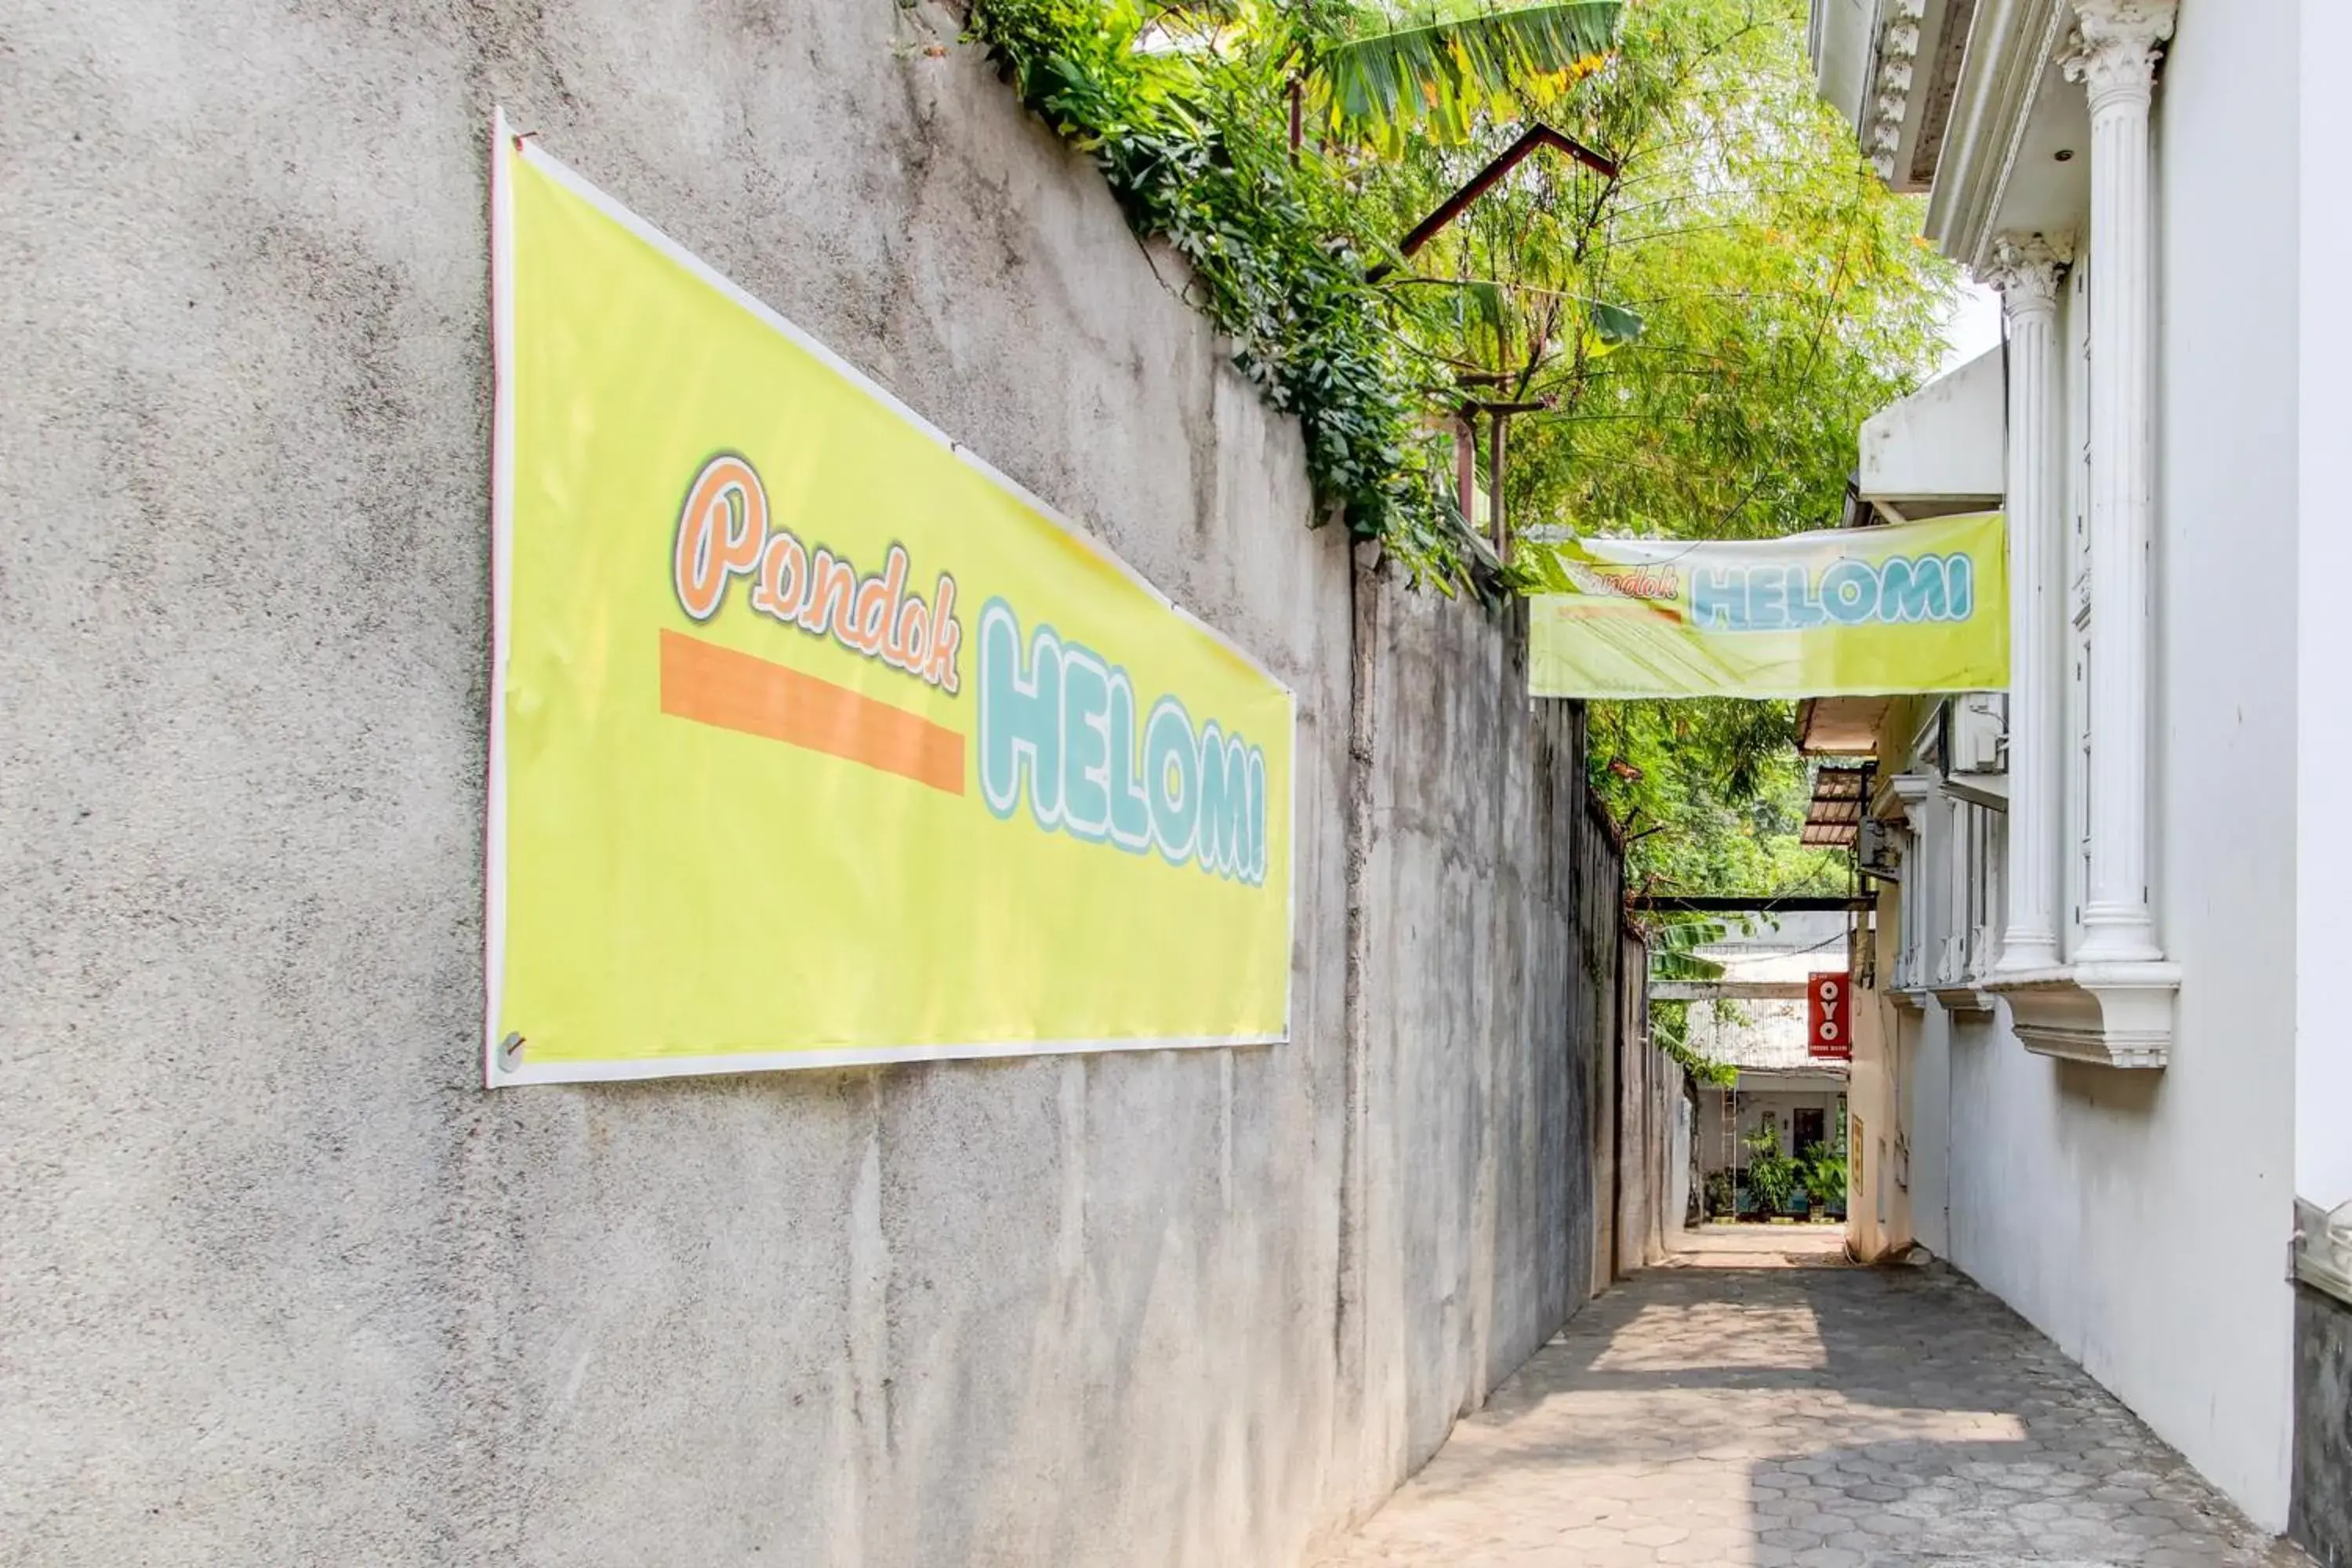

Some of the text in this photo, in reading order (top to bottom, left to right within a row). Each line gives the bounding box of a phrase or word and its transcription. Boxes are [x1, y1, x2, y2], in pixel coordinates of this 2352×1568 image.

[1572, 552, 1974, 631] ondok HELOMI
[672, 452, 1266, 887] Pondok HELOMI
[1820, 981, 1838, 1040] OYO
